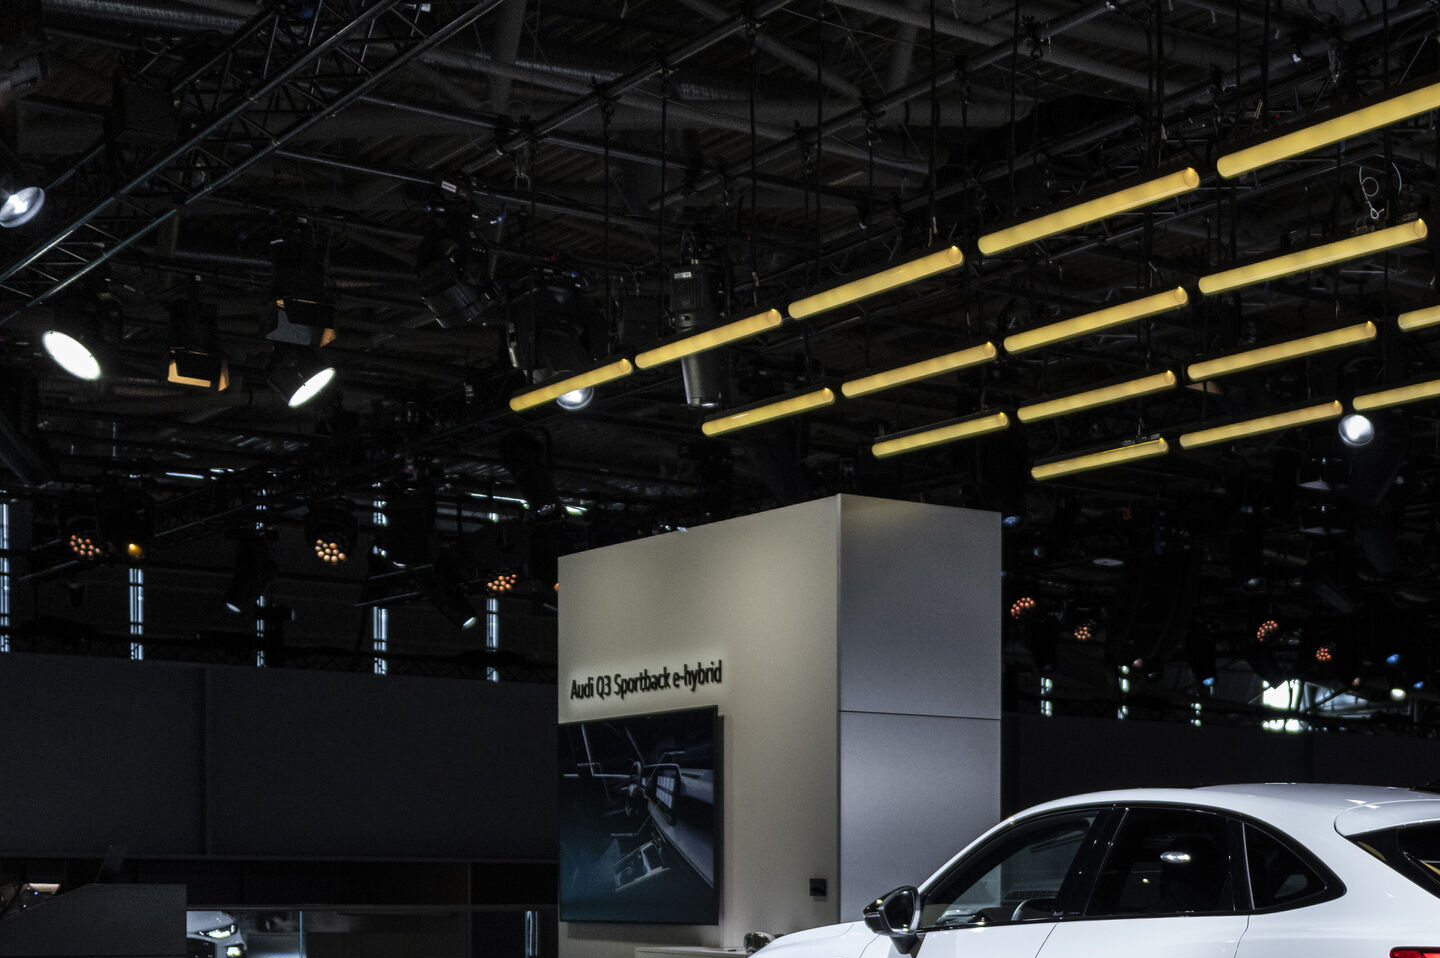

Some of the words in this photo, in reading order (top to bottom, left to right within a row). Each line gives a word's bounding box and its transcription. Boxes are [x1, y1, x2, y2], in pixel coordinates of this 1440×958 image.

[570, 677, 594, 700] Audi
[596, 675, 612, 700] Q3
[614, 666, 671, 700] Sportback
[672, 659, 723, 692] e-hybrid
